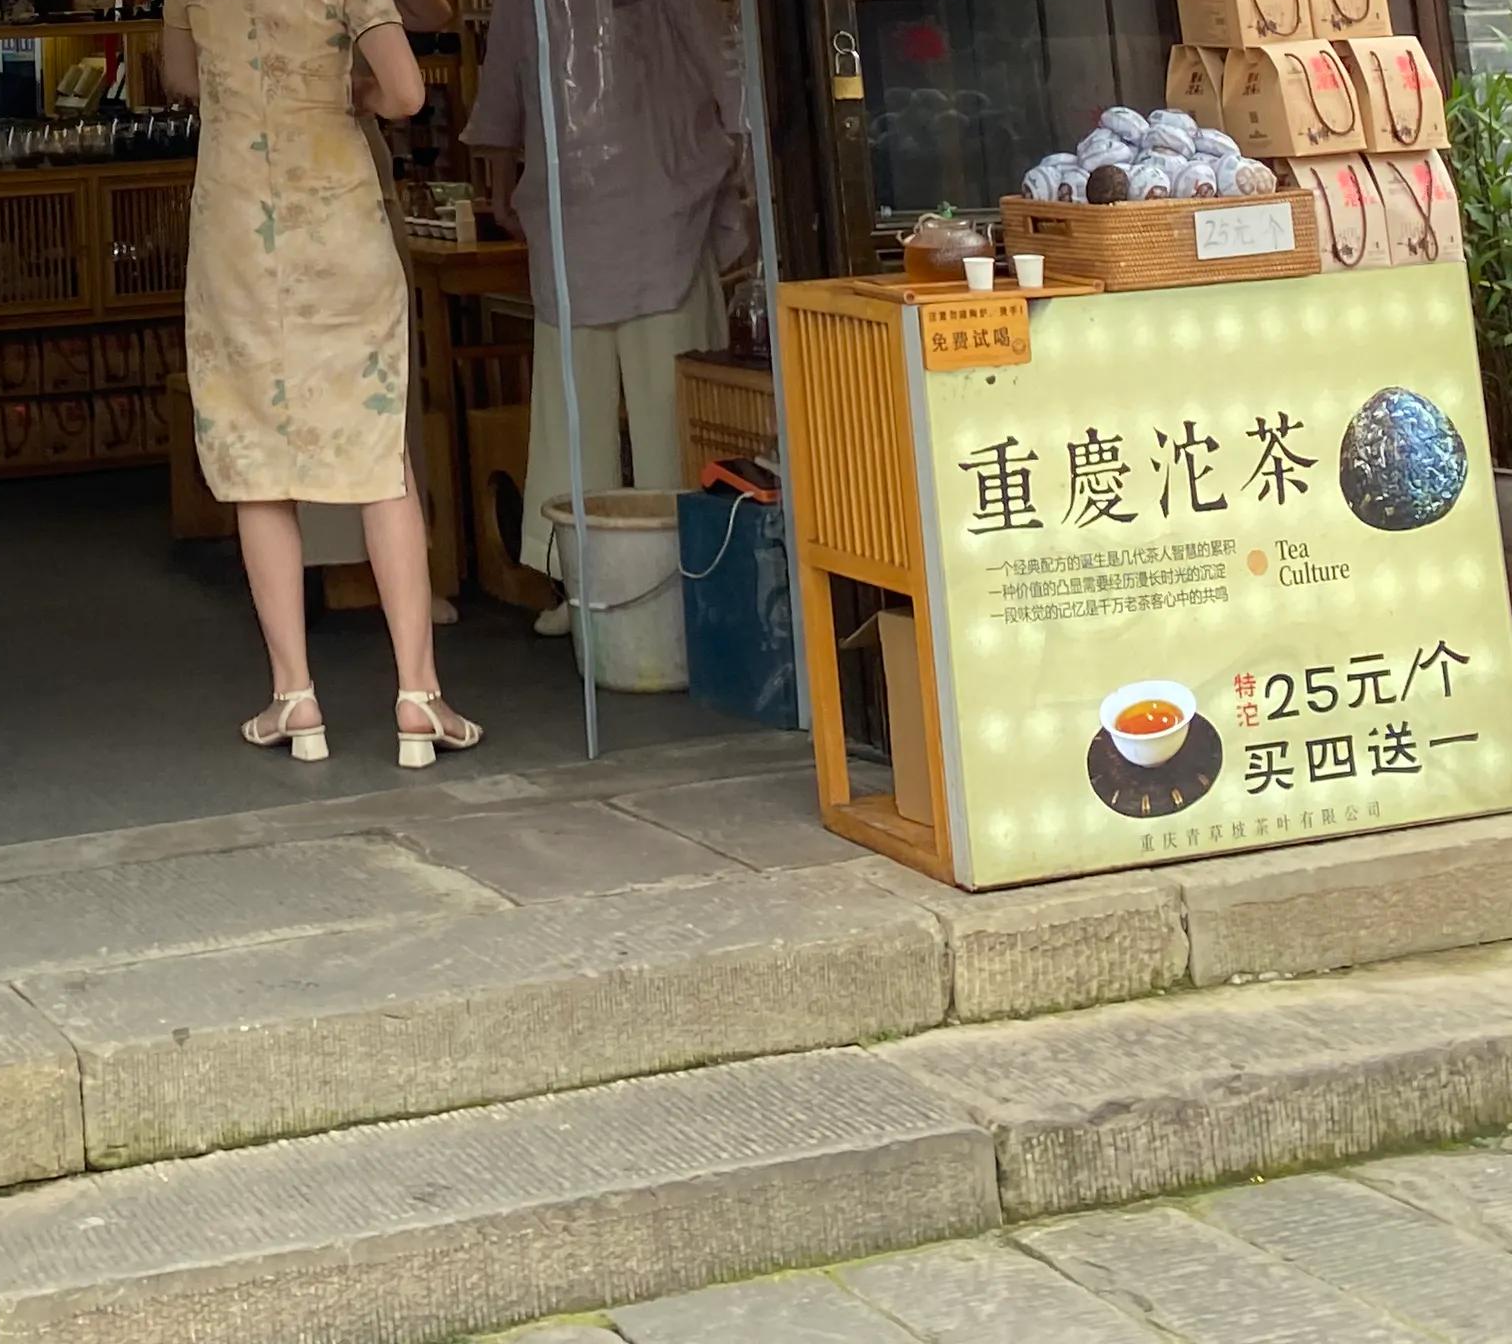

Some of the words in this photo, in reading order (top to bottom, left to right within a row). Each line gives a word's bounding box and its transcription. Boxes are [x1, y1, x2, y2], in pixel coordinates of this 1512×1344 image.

[932, 326, 1010, 353] 免费试喝
[958, 410, 1320, 536] 重慶沱茶
[986, 539, 1237, 577] 一个经典配方的诞生是几代茶人智慧的累积
[1275, 539, 1310, 561] Tea
[988, 563, 1227, 600] 一种价值的凸显需要经历漫长时光的沉淀
[1279, 561, 1351, 587] Culture
[990, 586, 1229, 625] 一段味觉的记忆是千万老茶客心中的共鸣
[1233, 672, 1260, 728] 特沱
[1264, 639, 1471, 722] 25元/个
[1244, 720, 1480, 796] 买四送一
[1140, 800, 1383, 853] 重庆青草坡茶叶有限公司
